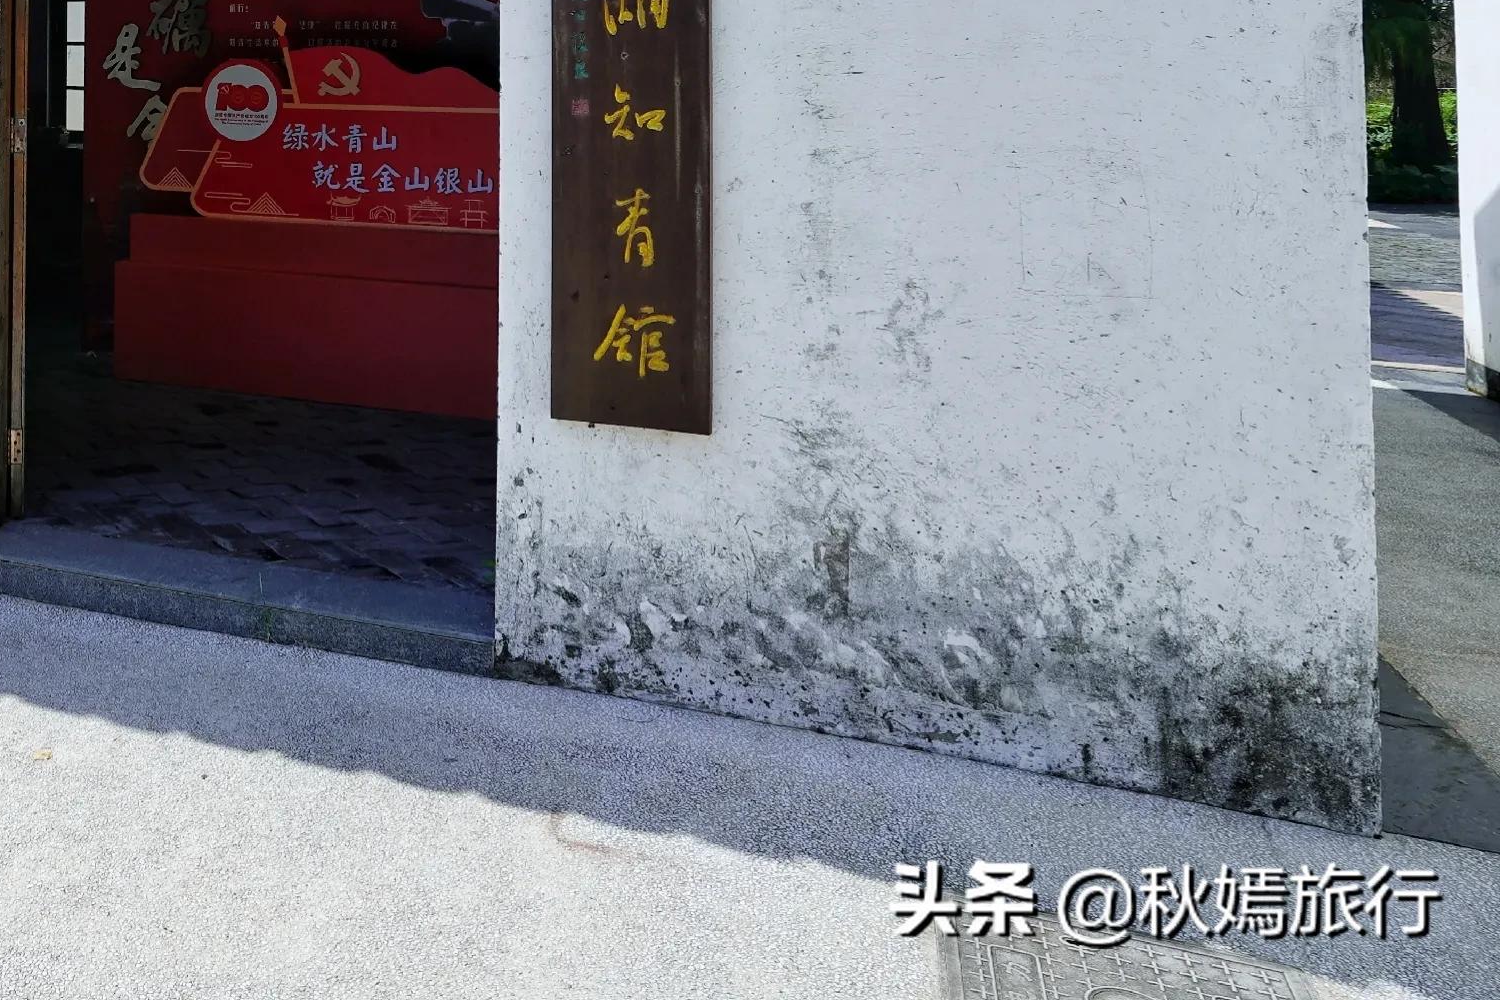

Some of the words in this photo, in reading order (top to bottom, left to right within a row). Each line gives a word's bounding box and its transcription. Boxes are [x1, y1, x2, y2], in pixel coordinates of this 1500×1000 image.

[282, 123, 397, 154] 绿水青山
[312, 160, 493, 195] 就是金山银山
